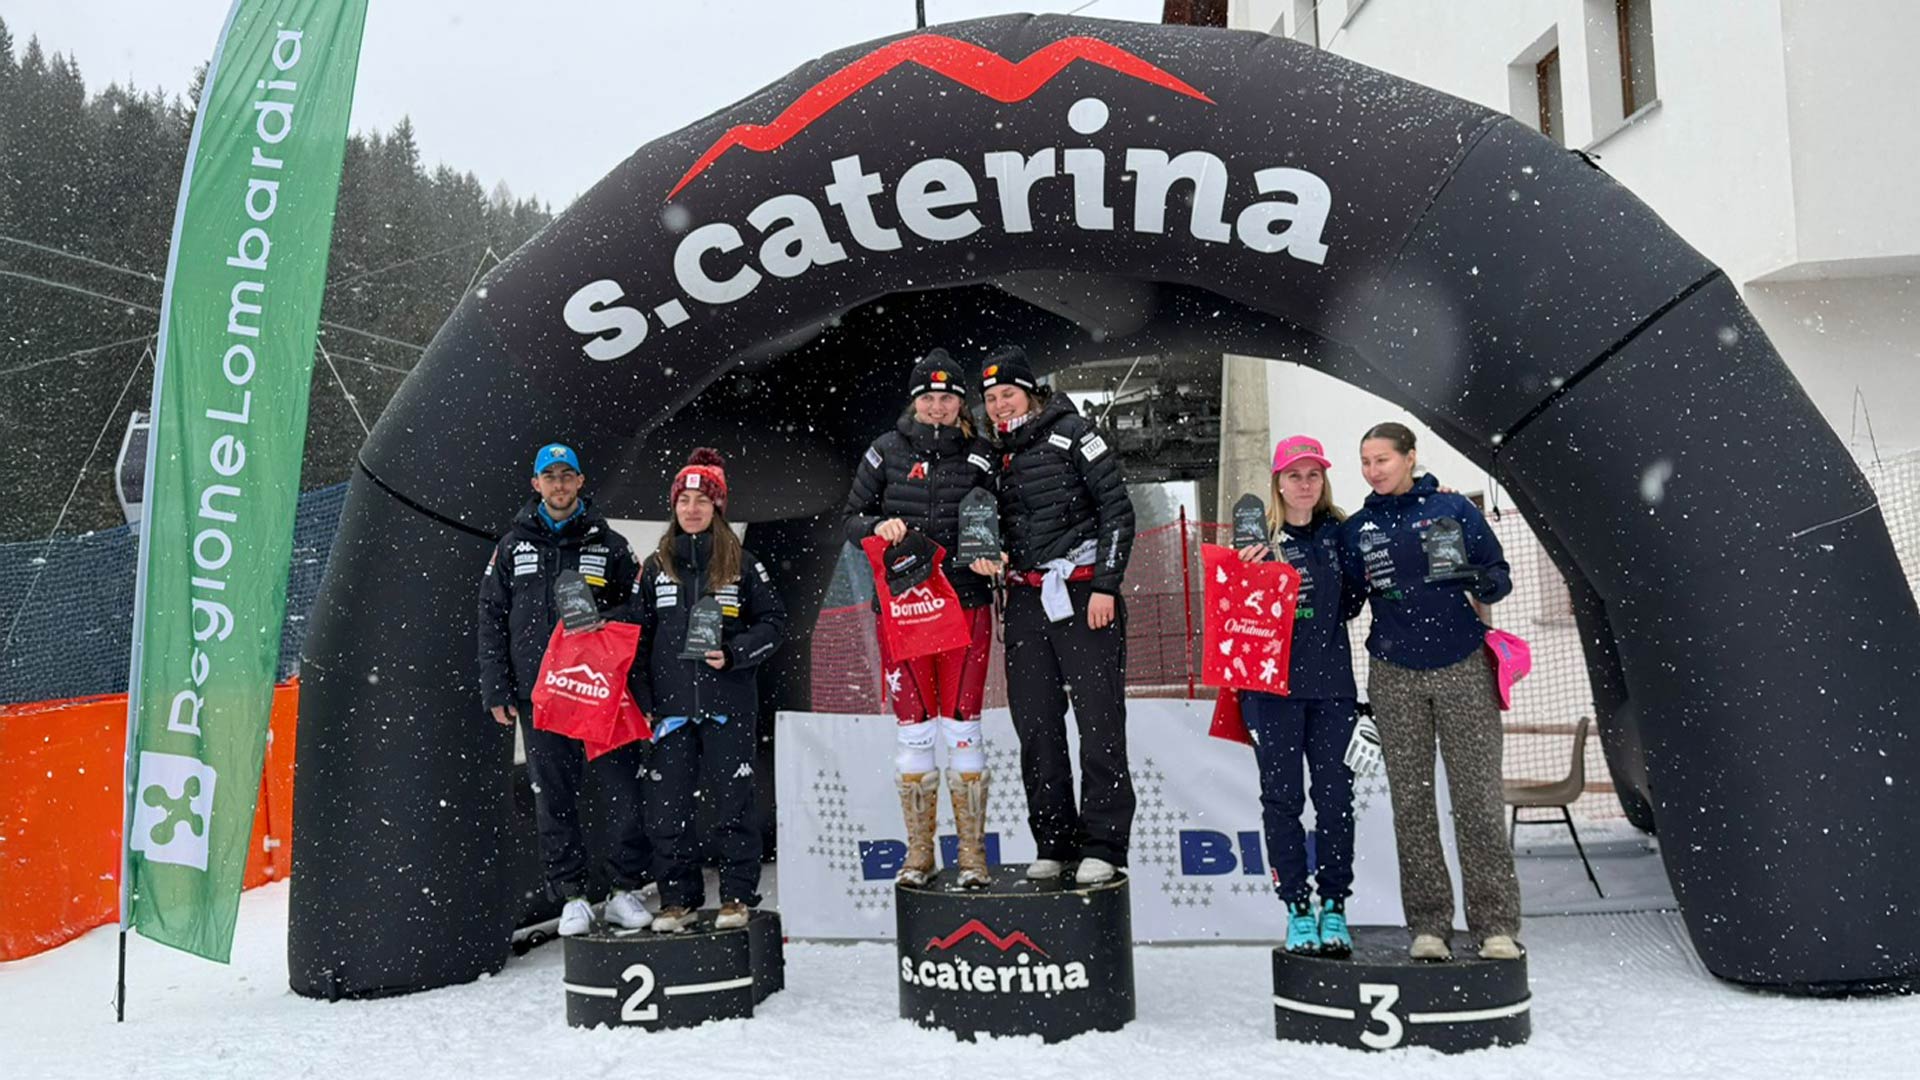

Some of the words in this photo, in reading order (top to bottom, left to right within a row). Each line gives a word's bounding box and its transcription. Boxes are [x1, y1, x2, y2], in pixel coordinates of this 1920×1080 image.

[562, 97, 1333, 362] s.caterina
[890, 595, 945, 618] bormio
[544, 670, 610, 699] bormio
[1179, 830, 1317, 876] BI
[621, 963, 659, 1021] 2
[901, 952, 1090, 993] s.caterina
[1359, 983, 1404, 1049] 3
